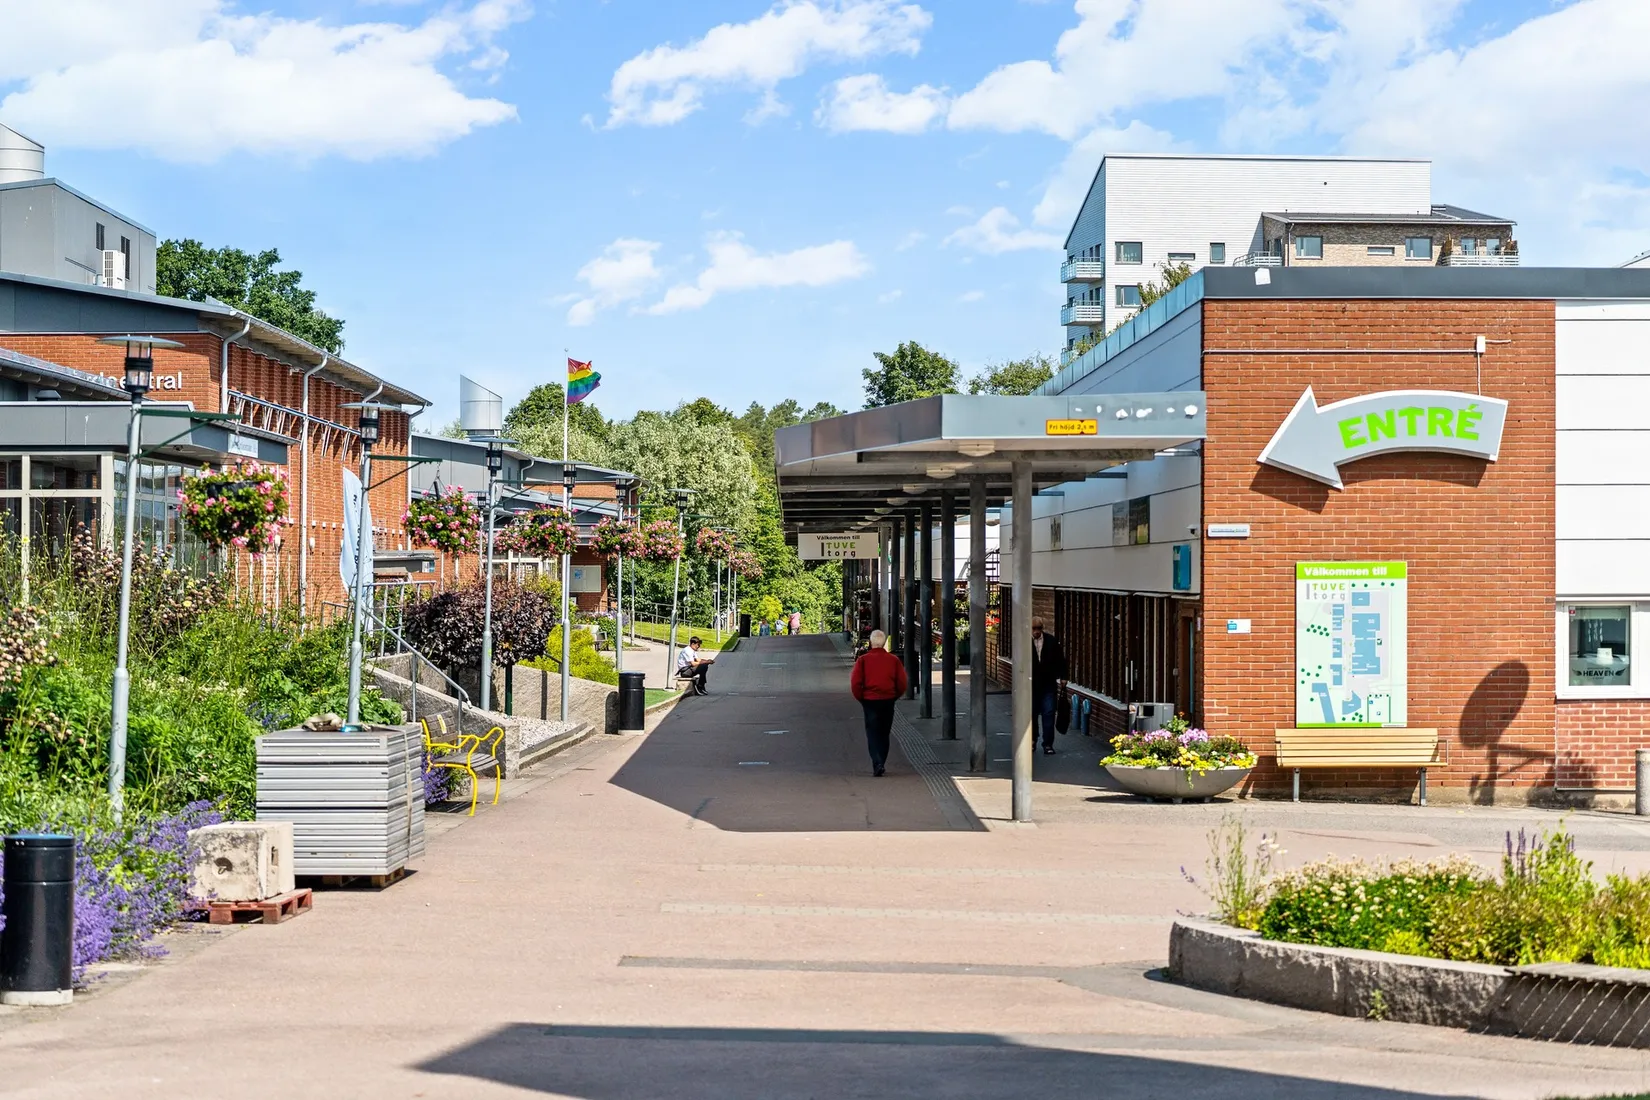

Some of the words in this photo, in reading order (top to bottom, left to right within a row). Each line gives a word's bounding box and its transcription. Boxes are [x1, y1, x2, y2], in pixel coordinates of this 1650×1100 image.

[1338, 404, 1483, 449] ENTRÉ
[827, 550, 856, 558] torg
[1304, 567, 1369, 576] Välkommen
[1372, 567, 1388, 576] till
[1312, 583, 1346, 591] TUVE
[1313, 592, 1346, 601] torg
